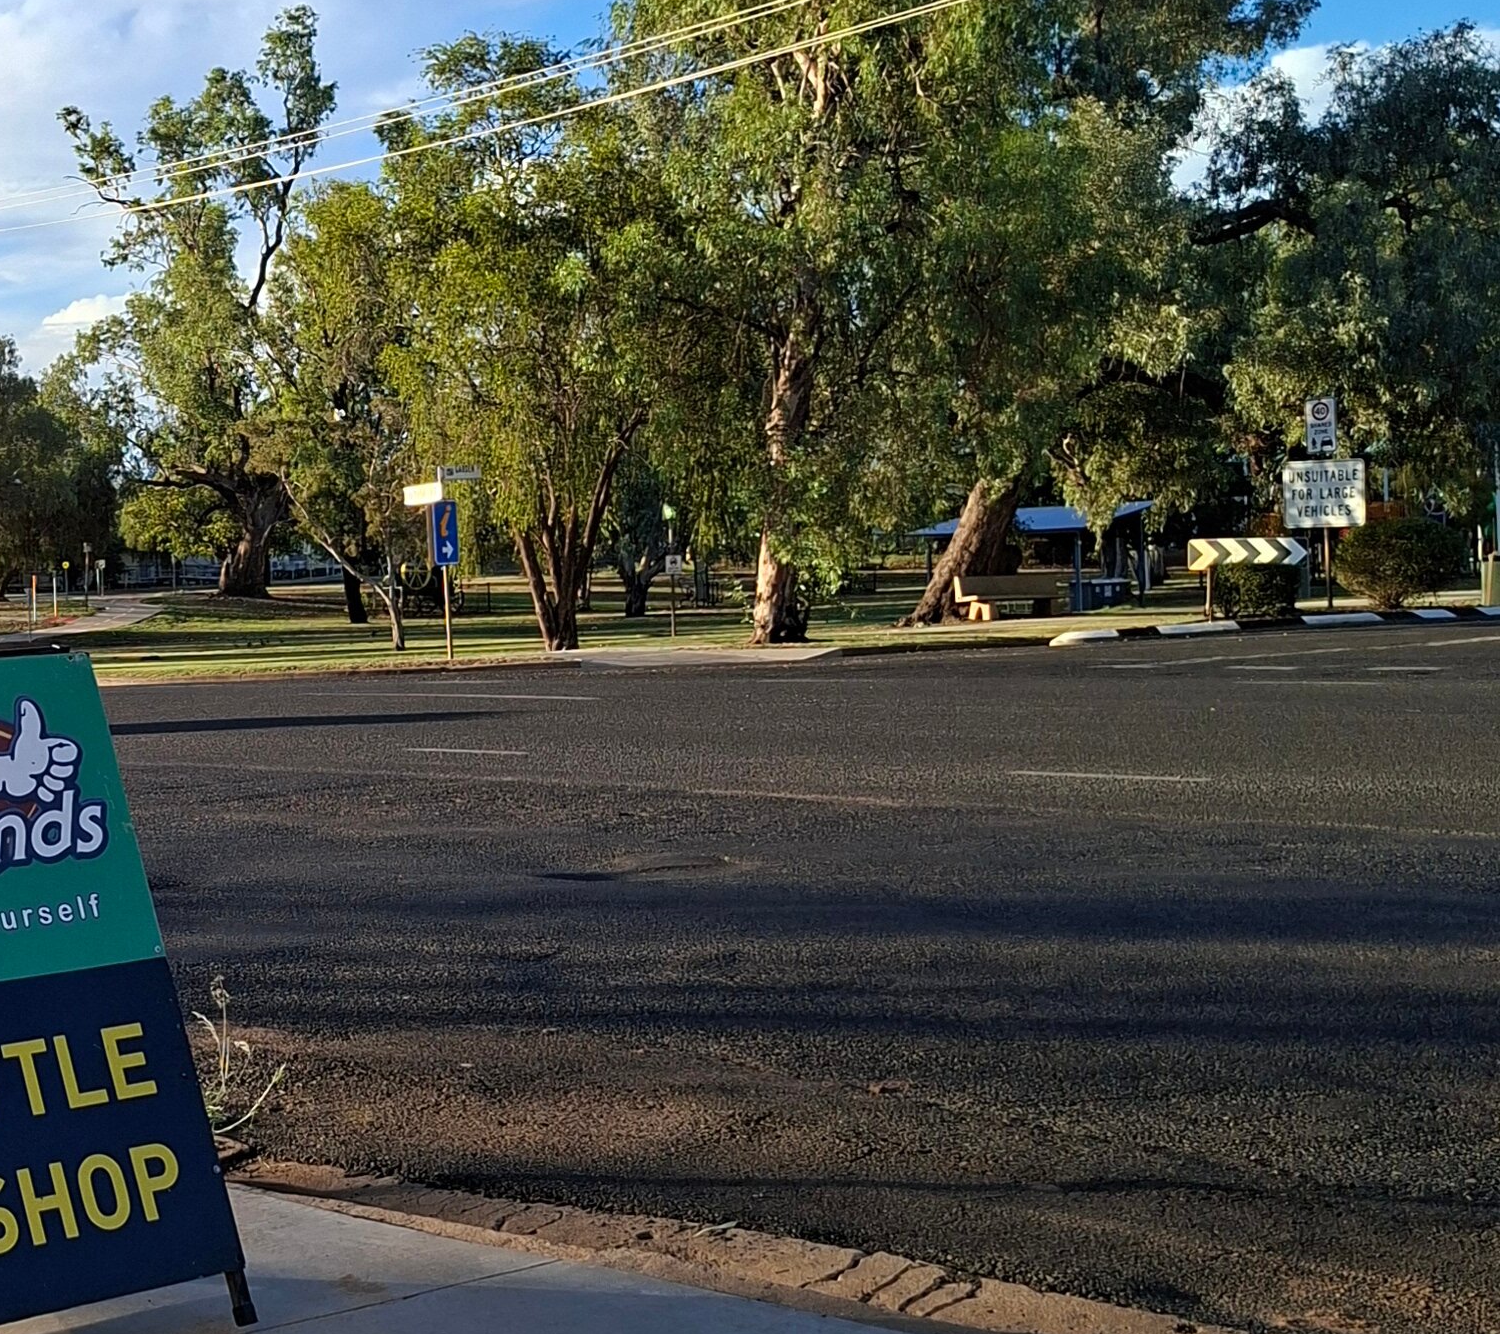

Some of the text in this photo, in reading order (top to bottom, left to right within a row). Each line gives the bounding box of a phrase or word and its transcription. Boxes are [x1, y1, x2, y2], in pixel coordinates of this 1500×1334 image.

[1314, 406, 1326, 416] 40
[1288, 468, 1359, 484] UNSUITABLE
[1291, 486, 1356, 501] FOR LARGE
[1297, 504, 1352, 518] VEHICLES
